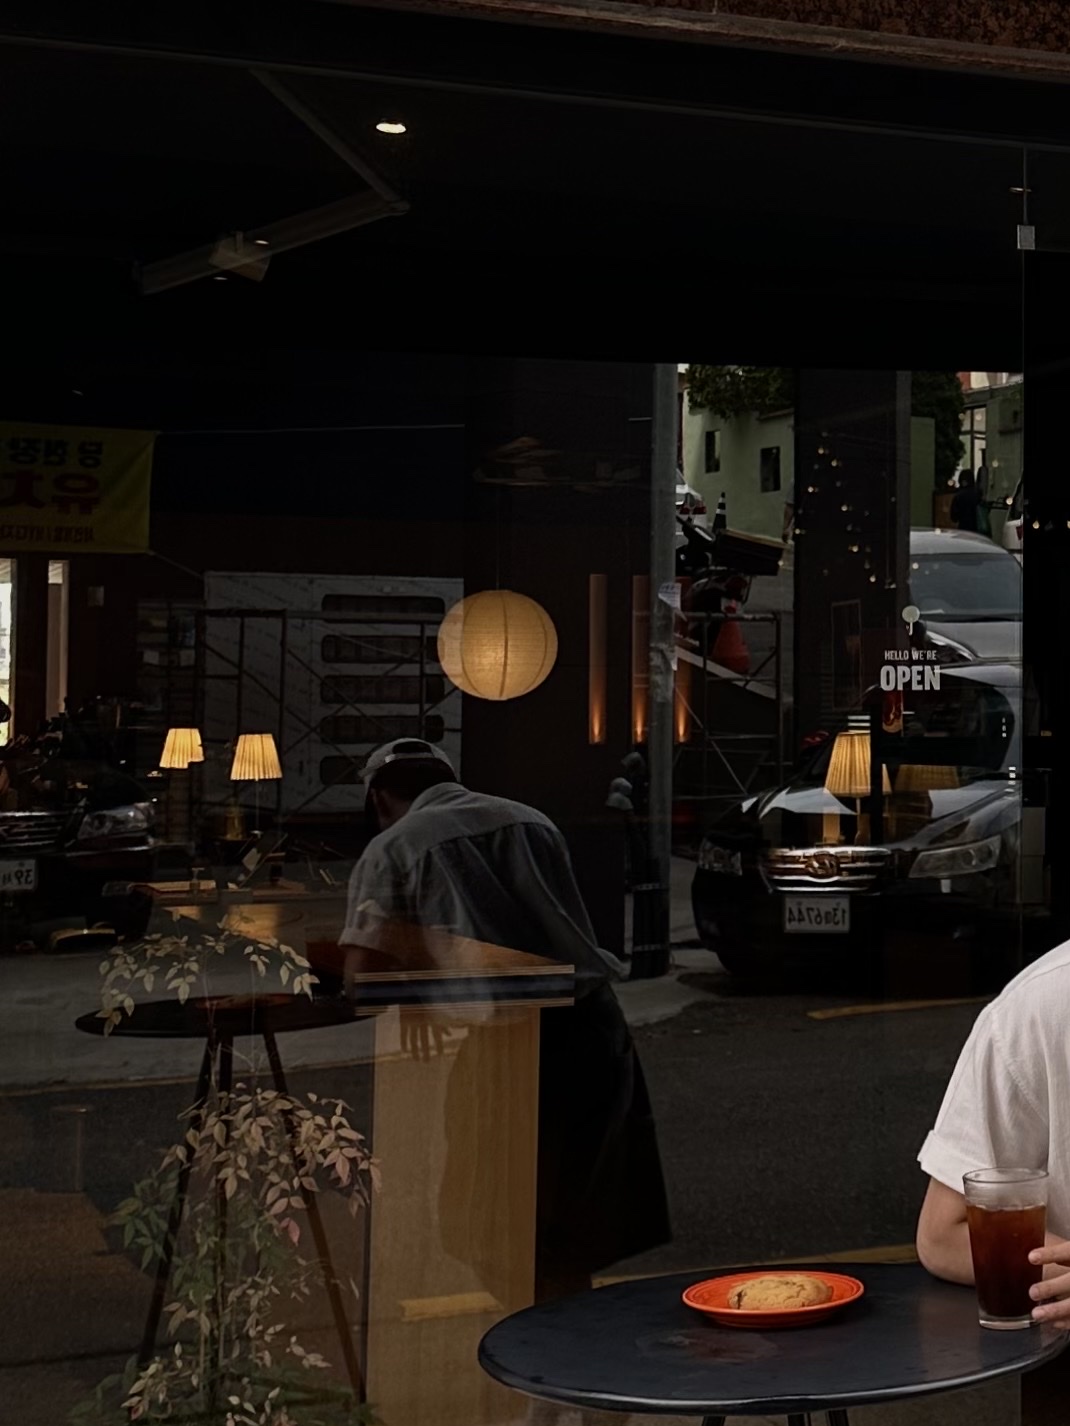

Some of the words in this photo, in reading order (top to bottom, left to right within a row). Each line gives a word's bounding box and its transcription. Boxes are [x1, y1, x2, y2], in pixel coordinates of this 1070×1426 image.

[884, 650, 909, 660] HELLO
[911, 649, 937, 660] WE'RE
[880, 665, 940, 691] OPEN
